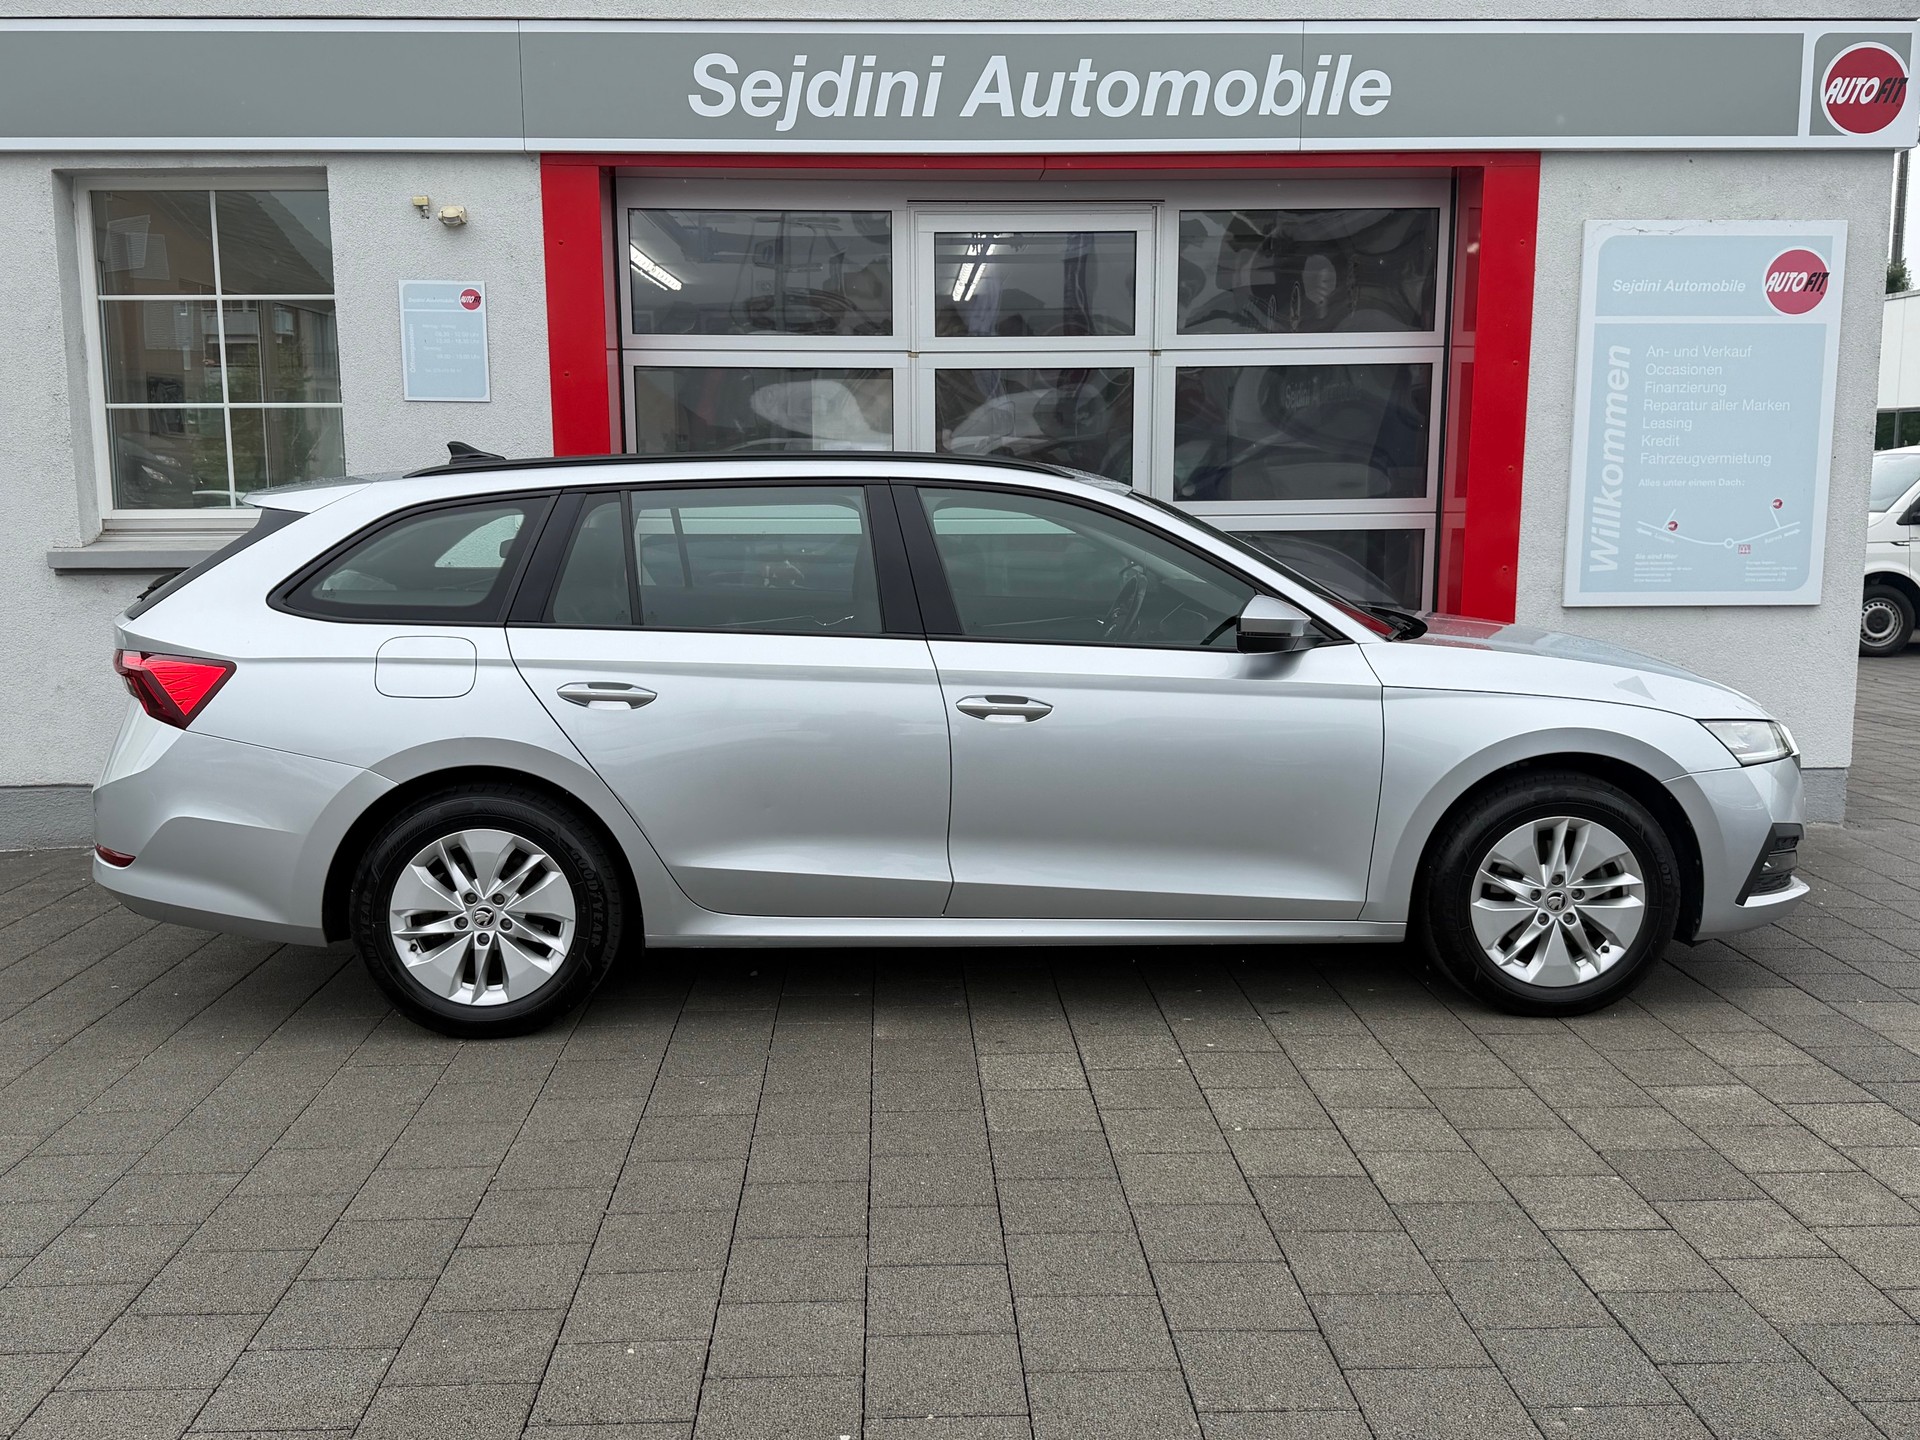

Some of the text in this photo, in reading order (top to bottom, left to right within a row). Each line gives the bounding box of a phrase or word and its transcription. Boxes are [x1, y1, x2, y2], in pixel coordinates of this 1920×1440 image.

[688, 53, 1392, 132] Sejdini Automobile
[1825, 77, 1909, 104] AUTOFIT
[1612, 279, 1746, 295] Sejdini Automobile
[1765, 271, 1830, 292] AUTOFIT
[1646, 345, 1753, 358] An- und Verkauf
[1645, 363, 1723, 376] Occasionen
[1644, 381, 1727, 396] Finanzierung
[1643, 398, 1791, 413] Reparatur aller Marken
[1642, 416, 1693, 432] Leasing
[1641, 434, 1681, 447] Kredit
[1589, 344, 1631, 572] Willkommen
[1640, 452, 1772, 467] Fahrzeugvermietung
[1638, 477, 1746, 488] Alles unter einem Dach:
